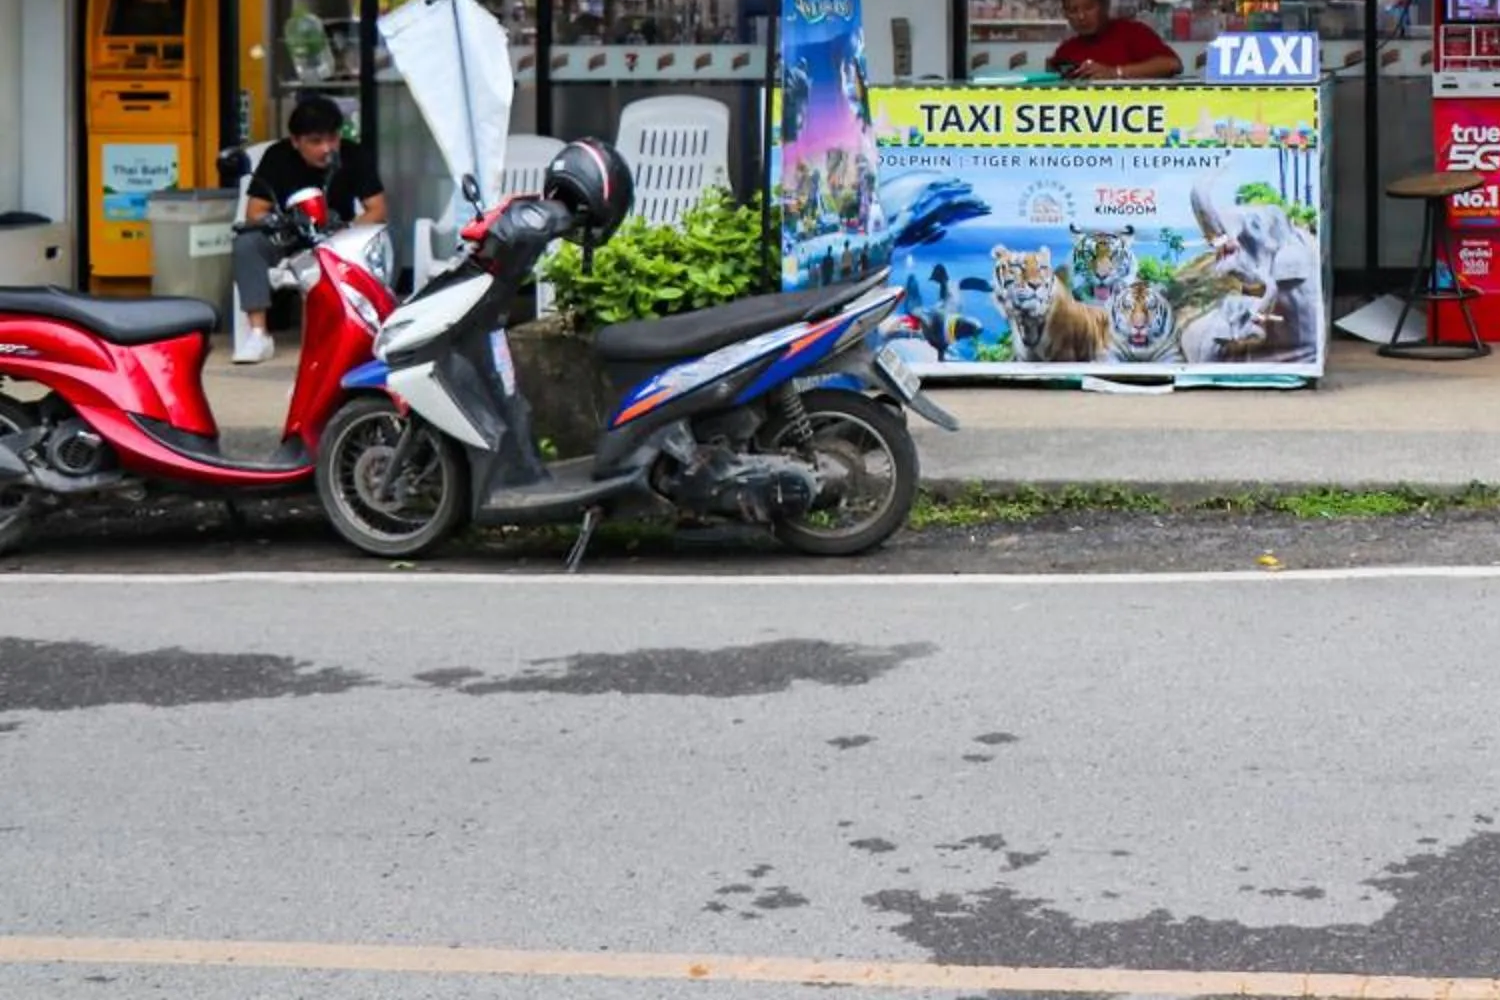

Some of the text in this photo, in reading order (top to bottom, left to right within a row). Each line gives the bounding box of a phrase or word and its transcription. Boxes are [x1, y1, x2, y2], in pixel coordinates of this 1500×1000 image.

[1211, 35, 1313, 76] TAXI
[920, 104, 1165, 133] TAXI SERVICE
[973, 155, 1022, 168] TIGER
[1029, 155, 1113, 168] KINGDOM
[1132, 155, 1221, 168] ELEPHANT
[1095, 188, 1156, 205] TIGER
[1453, 185, 1499, 209] No.1
[1095, 205, 1157, 216] KINGDOM
